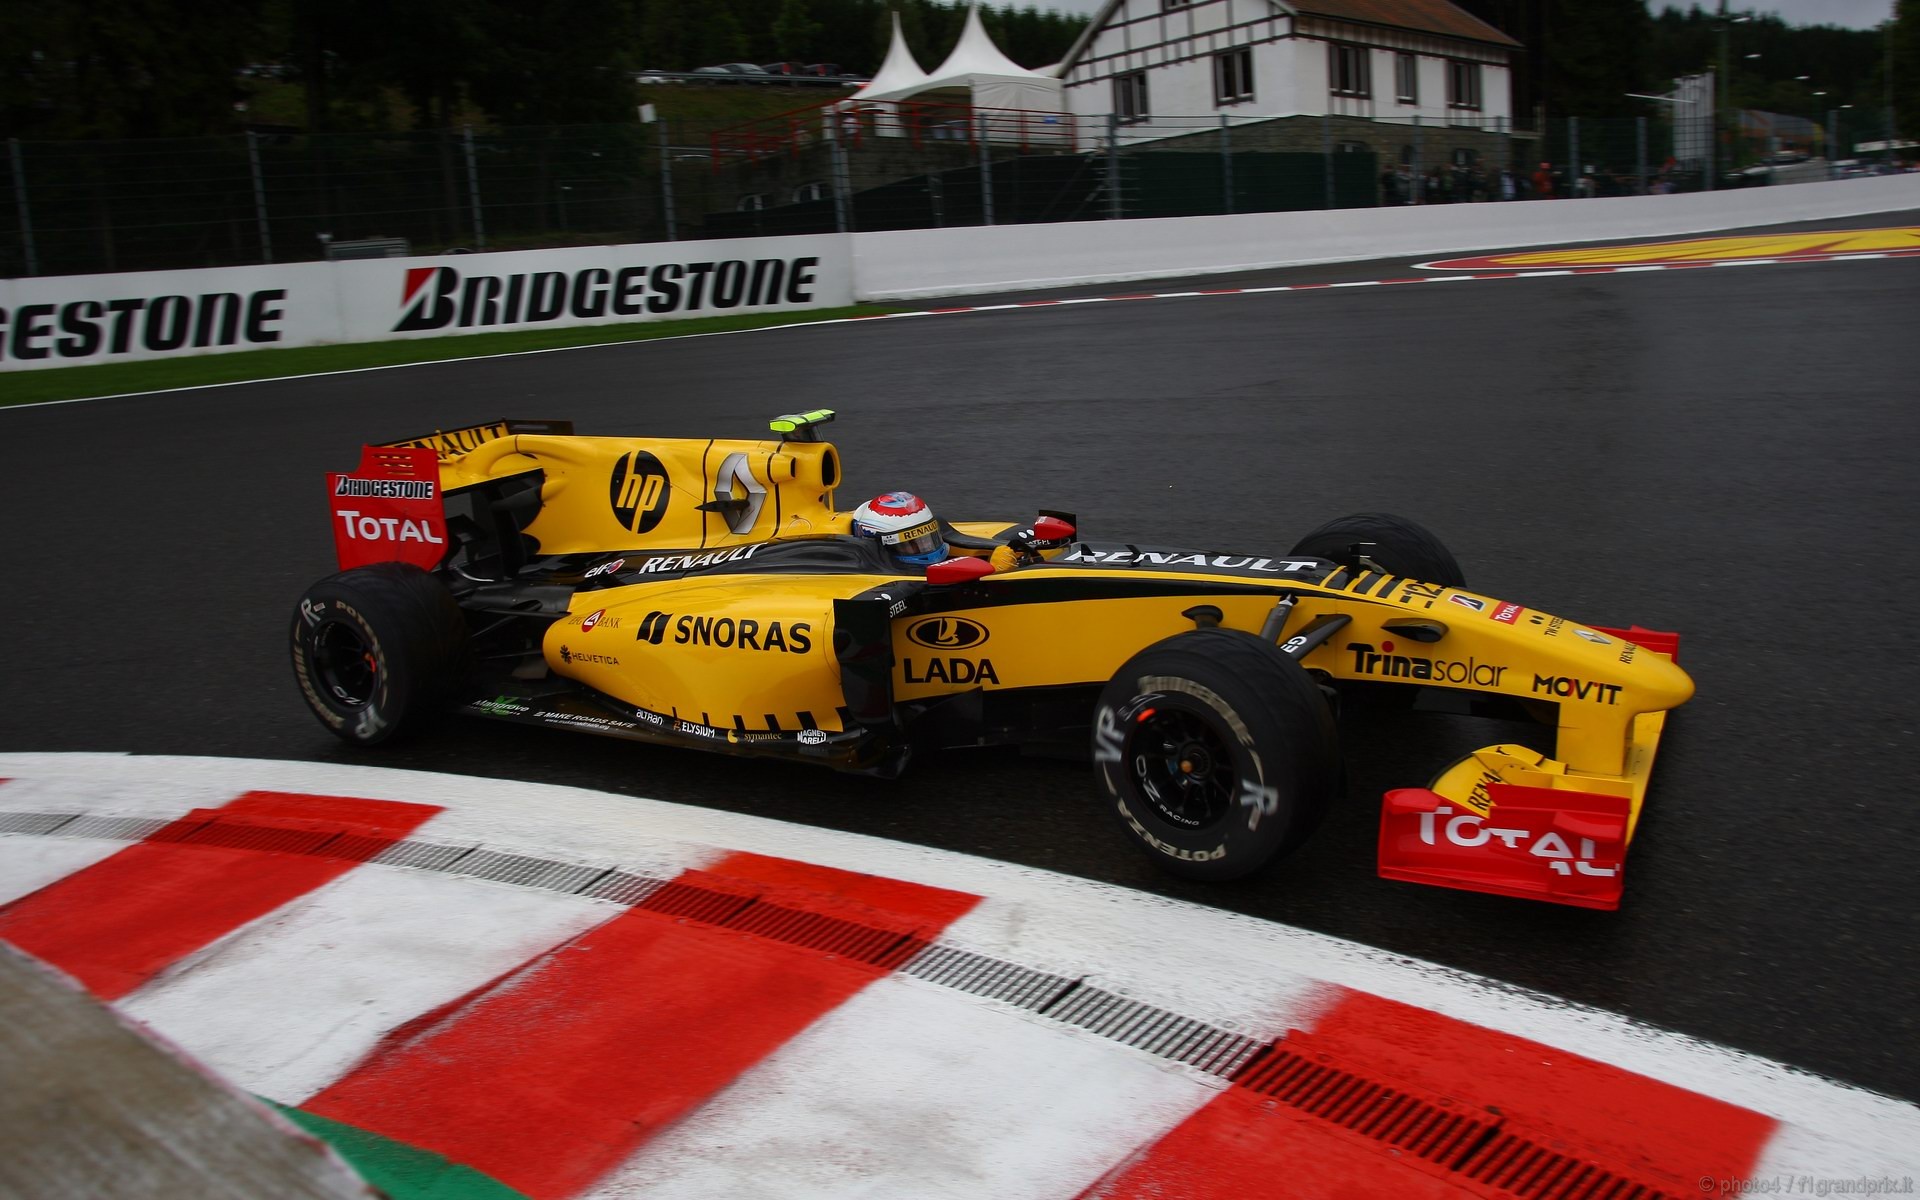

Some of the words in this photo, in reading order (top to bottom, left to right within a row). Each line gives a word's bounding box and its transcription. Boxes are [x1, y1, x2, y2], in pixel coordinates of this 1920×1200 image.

[392, 256, 820, 332] BRIDGESTONE
[0, 288, 287, 362] ESTONE
[335, 474, 434, 500] BRIDGESTONE
[616, 450, 665, 532] hp
[336, 510, 443, 544] TOTAL
[584, 563, 609, 578] elf
[639, 542, 769, 575] RENAULT
[1064, 549, 1317, 572] RENAULT
[889, 600, 907, 618] STEEL
[1495, 604, 1520, 622] TOTAL
[675, 615, 812, 654] SNORAS
[571, 652, 620, 666] HELVETICA
[903, 657, 1000, 685] LADA
[682, 721, 715, 739] ELYSIUM
[744, 731, 783, 743] symantec
[1159, 804, 1200, 827] RACING
[1415, 806, 1620, 878] TOTAL
